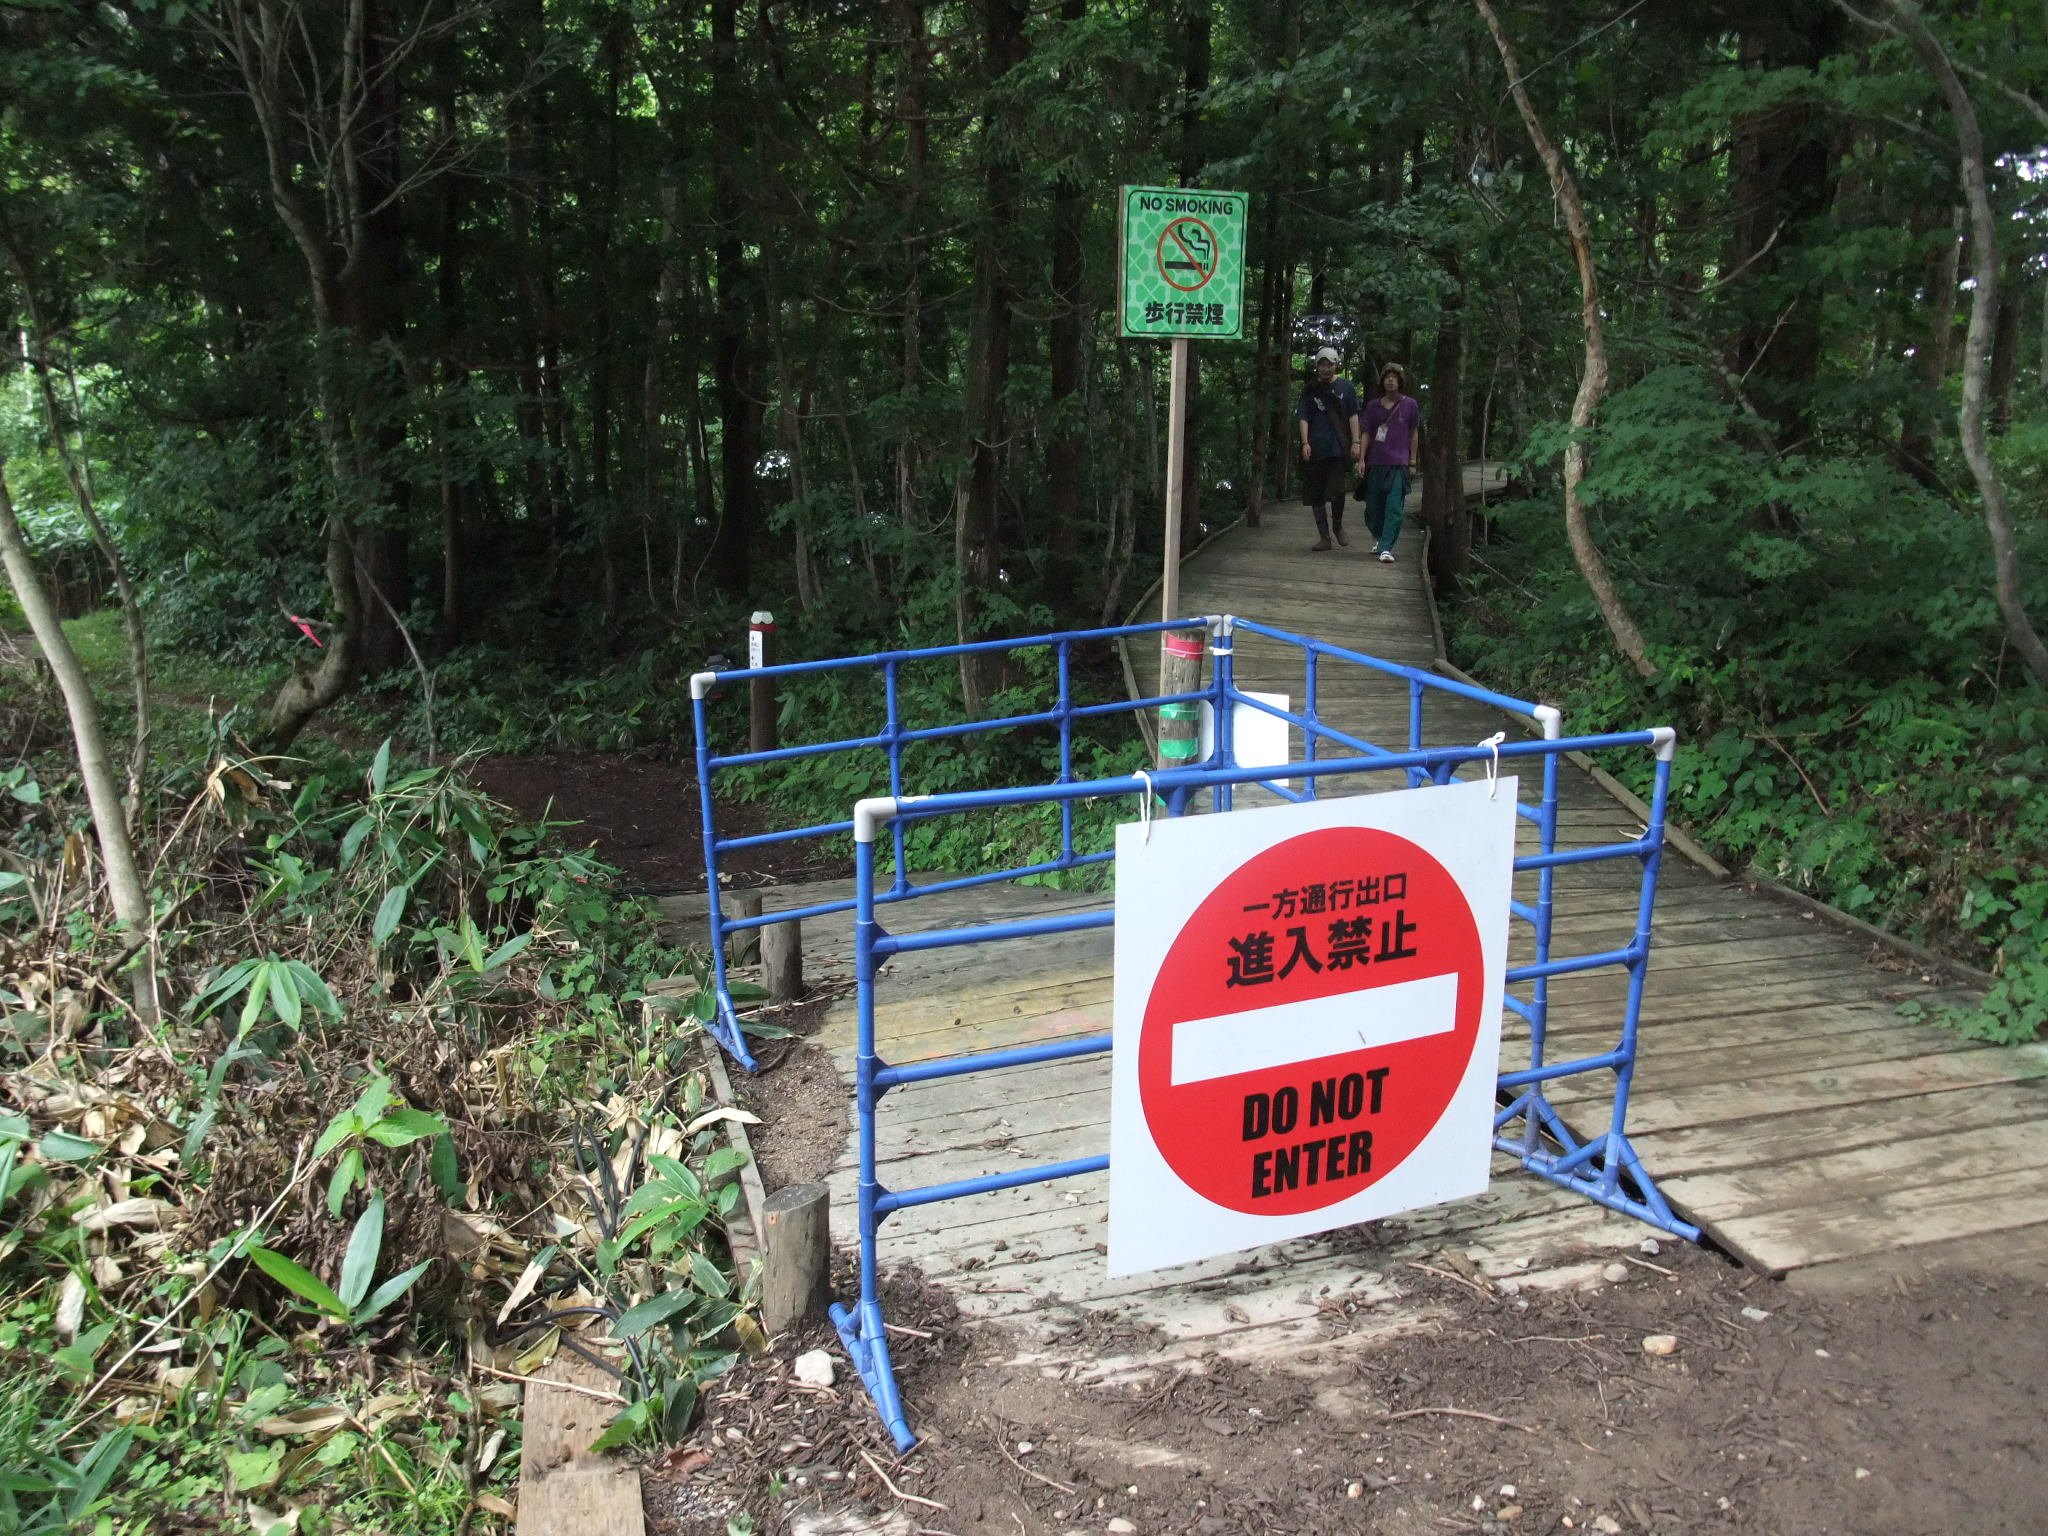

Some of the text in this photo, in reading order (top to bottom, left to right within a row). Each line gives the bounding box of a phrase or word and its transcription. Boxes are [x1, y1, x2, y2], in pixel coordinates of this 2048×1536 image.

[1139, 196, 1233, 215] NO SMOKING
[1145, 301, 1224, 325] 歩行禁煙
[1243, 872, 1407, 921] 一方通行出口
[1225, 909, 1417, 989] 進入禁止
[1242, 1067, 1389, 1142] DO NOT
[1251, 1130, 1372, 1198] ENTER
